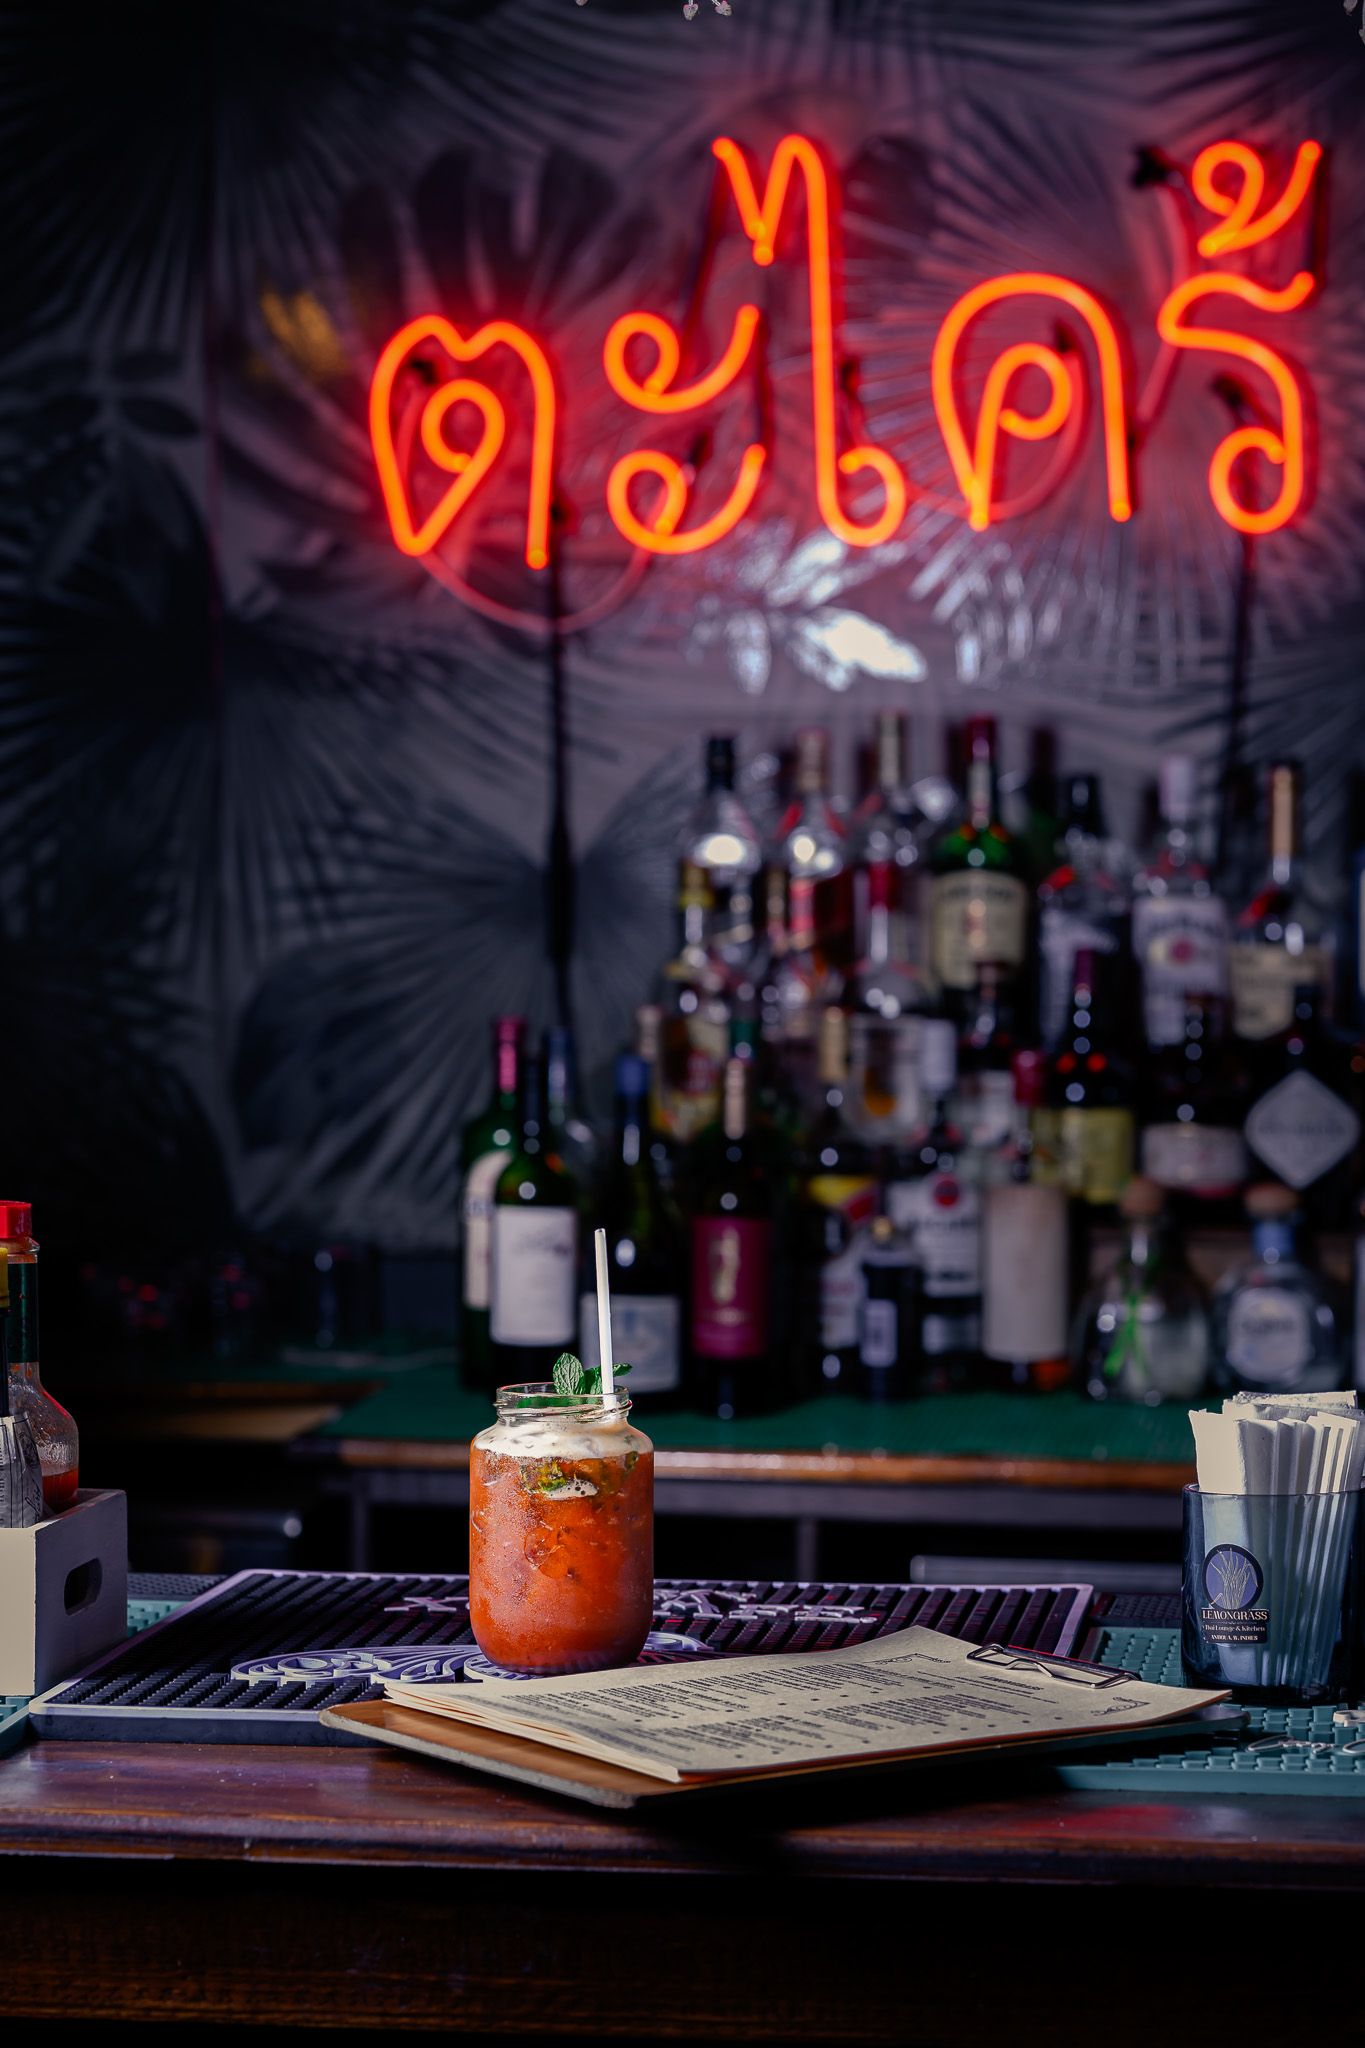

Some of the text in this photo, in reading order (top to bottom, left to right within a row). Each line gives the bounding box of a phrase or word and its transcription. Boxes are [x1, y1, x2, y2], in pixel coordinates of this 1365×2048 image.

[370, 135, 1322, 568] ตะไคร้
[1202, 1610, 1268, 1620] LEMONGRASS
